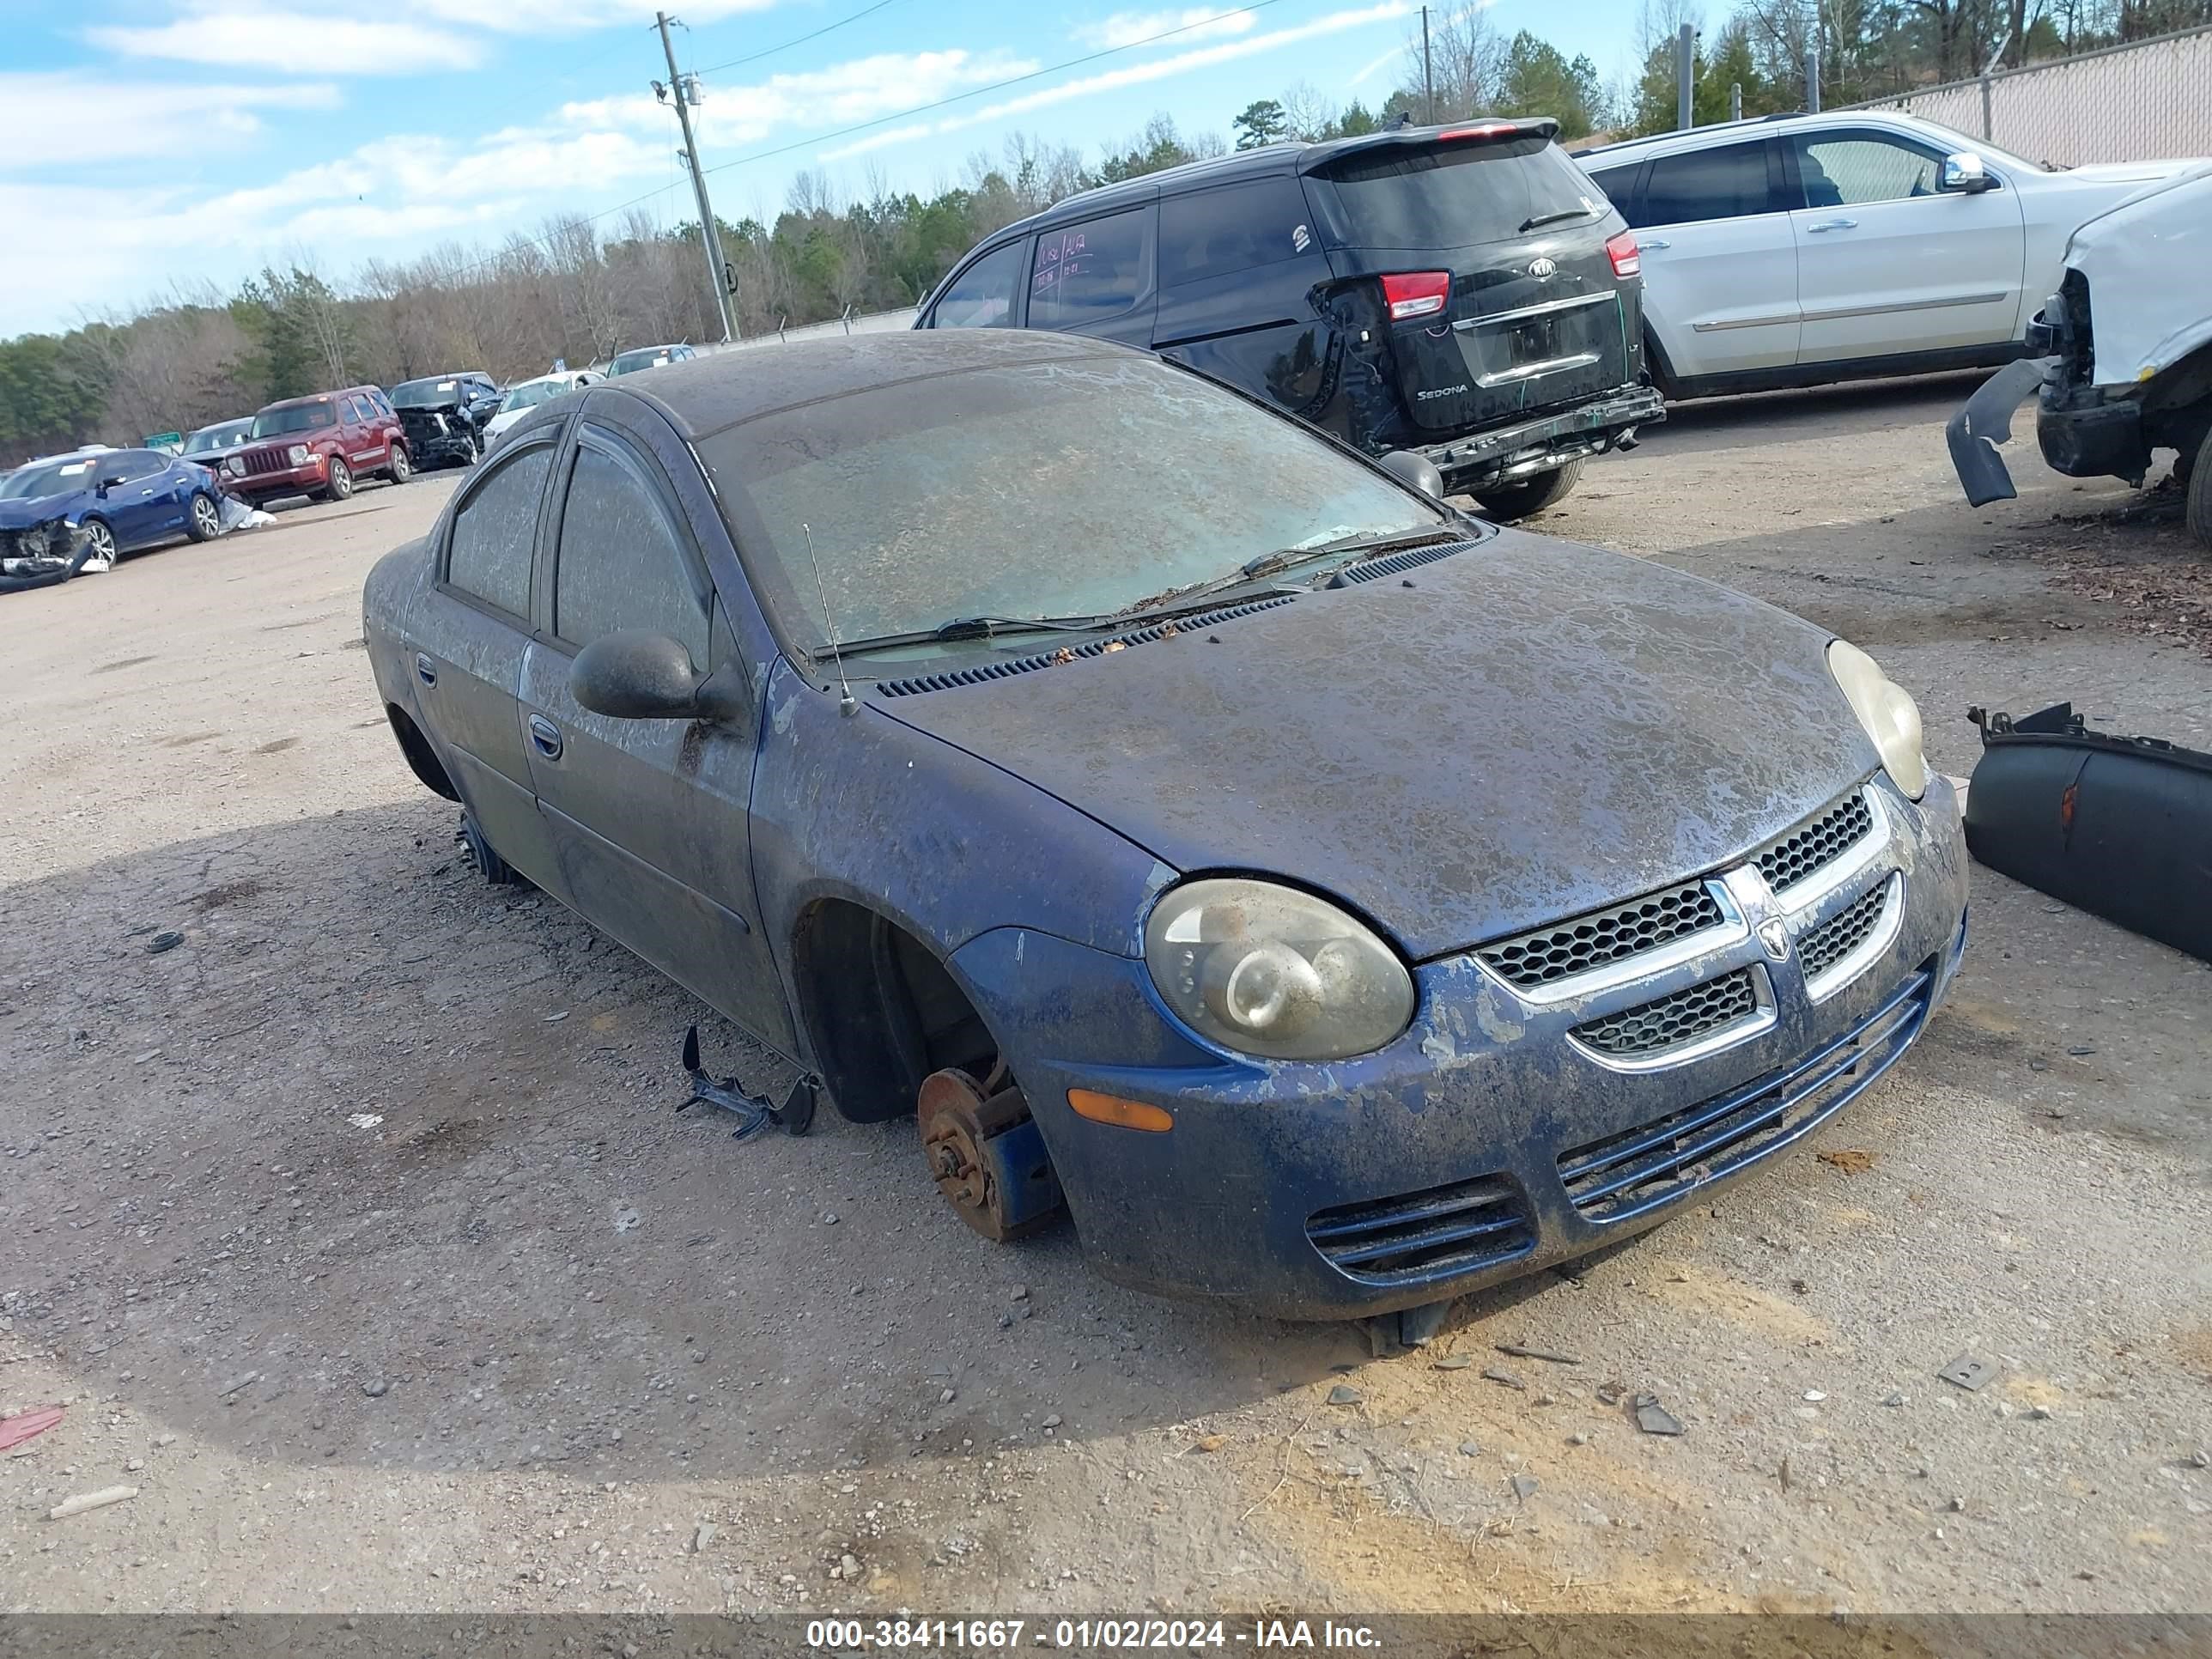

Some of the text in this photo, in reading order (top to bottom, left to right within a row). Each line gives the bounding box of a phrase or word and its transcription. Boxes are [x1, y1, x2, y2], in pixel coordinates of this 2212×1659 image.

[1531, 259, 1553, 276] KIA
[1628, 343, 1638, 352] LX
[1417, 384, 1468, 401] SEDONA
